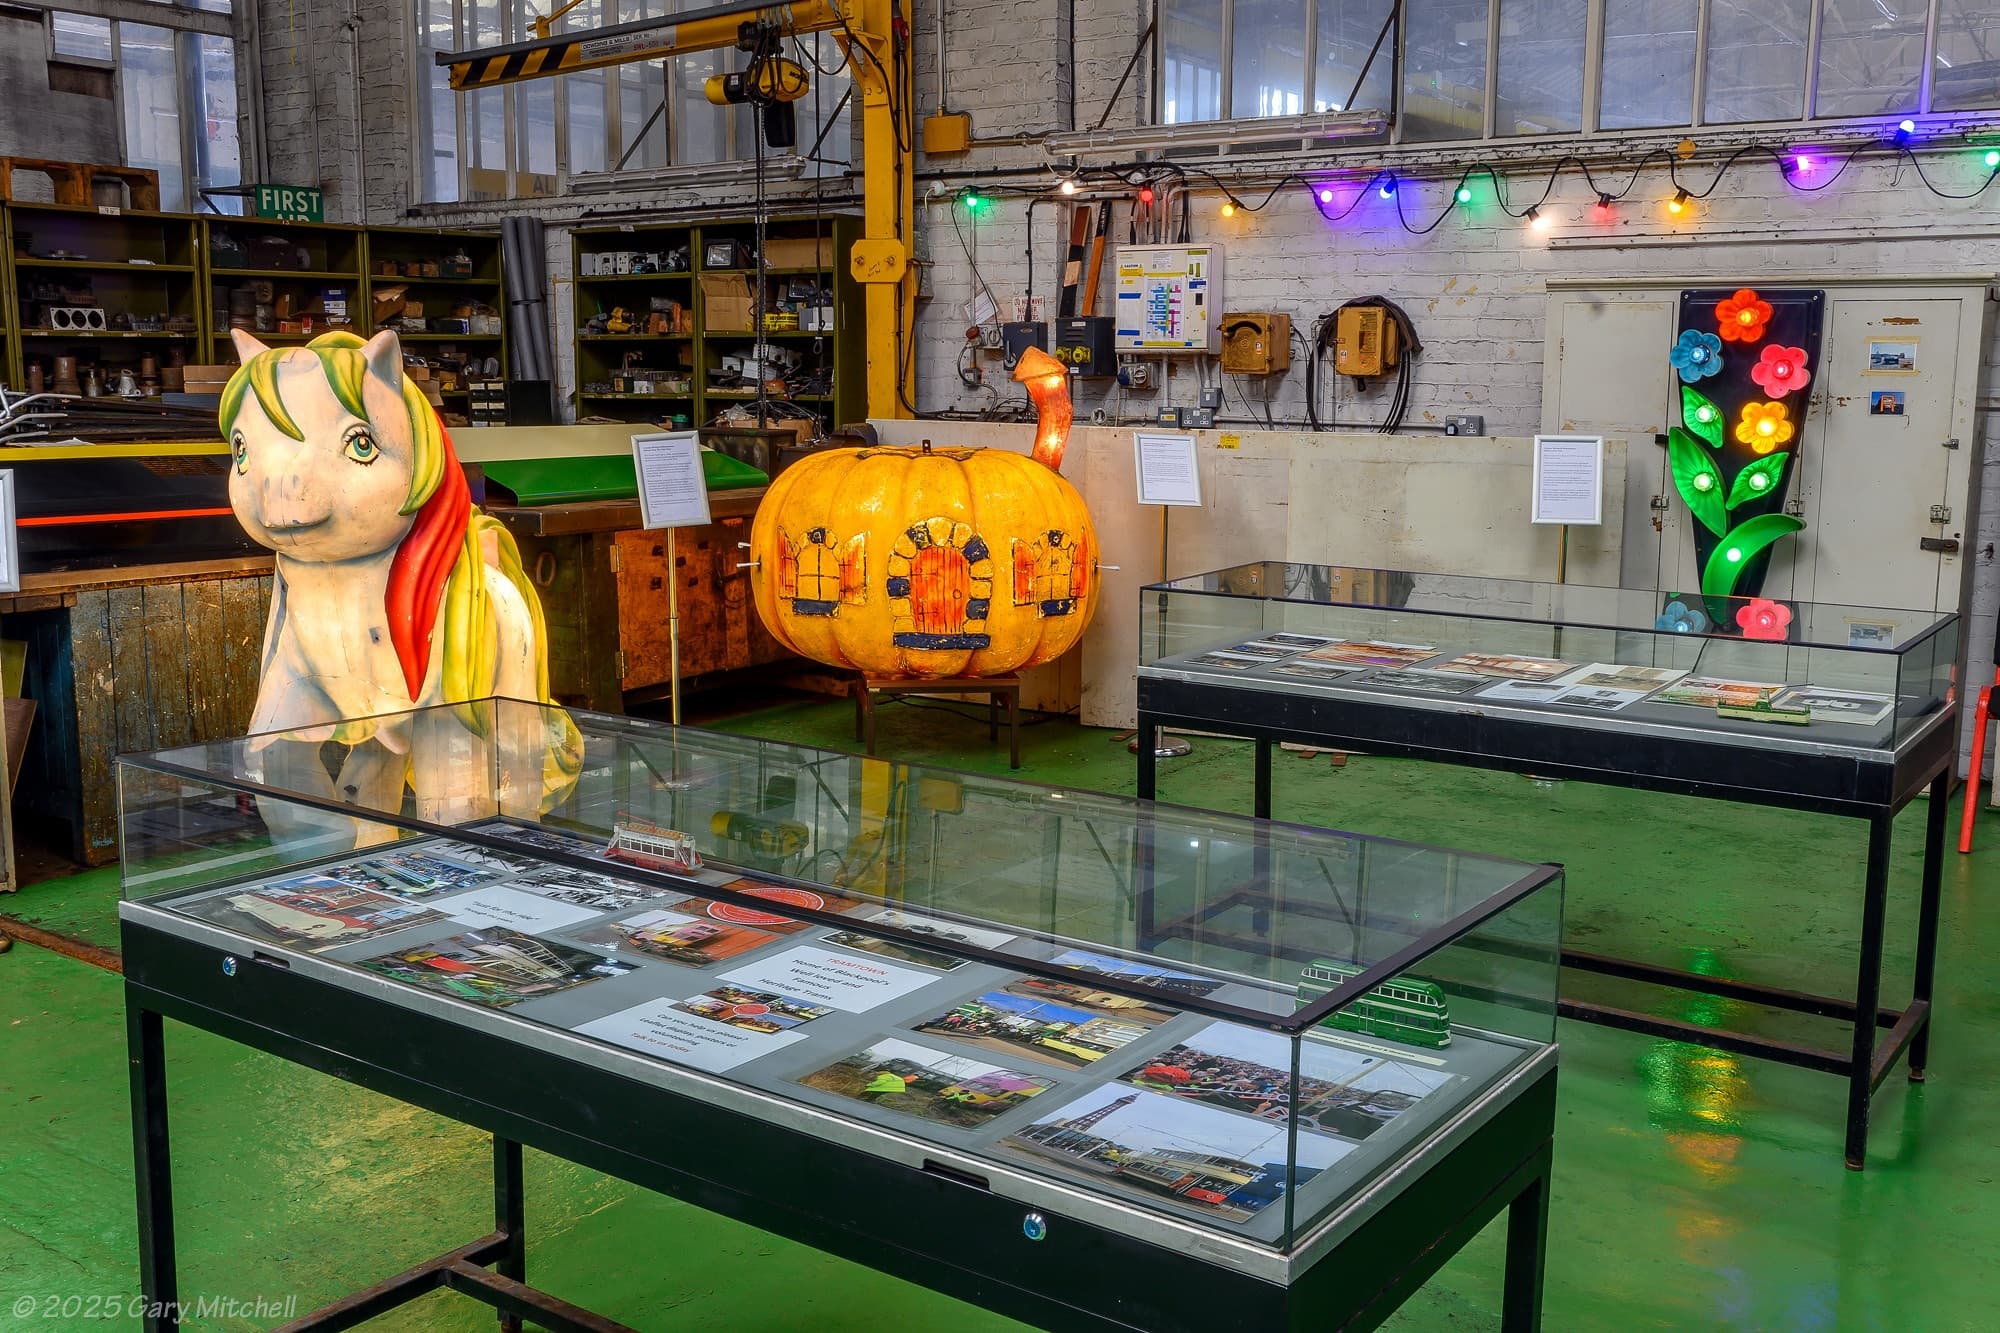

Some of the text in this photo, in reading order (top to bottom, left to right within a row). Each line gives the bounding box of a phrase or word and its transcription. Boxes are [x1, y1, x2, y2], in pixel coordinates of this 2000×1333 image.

[262, 188, 320, 213] FIRST
[792, 958, 822, 970] Home
[835, 969, 891, 986] Blackpool's
[759, 977, 833, 1001] Heritage Trams
[792, 977, 831, 991] Famous
[813, 973, 841, 985] loved
[841, 979, 864, 989] and
[689, 1022, 706, 1031] help
[668, 1043, 691, 1053] today
